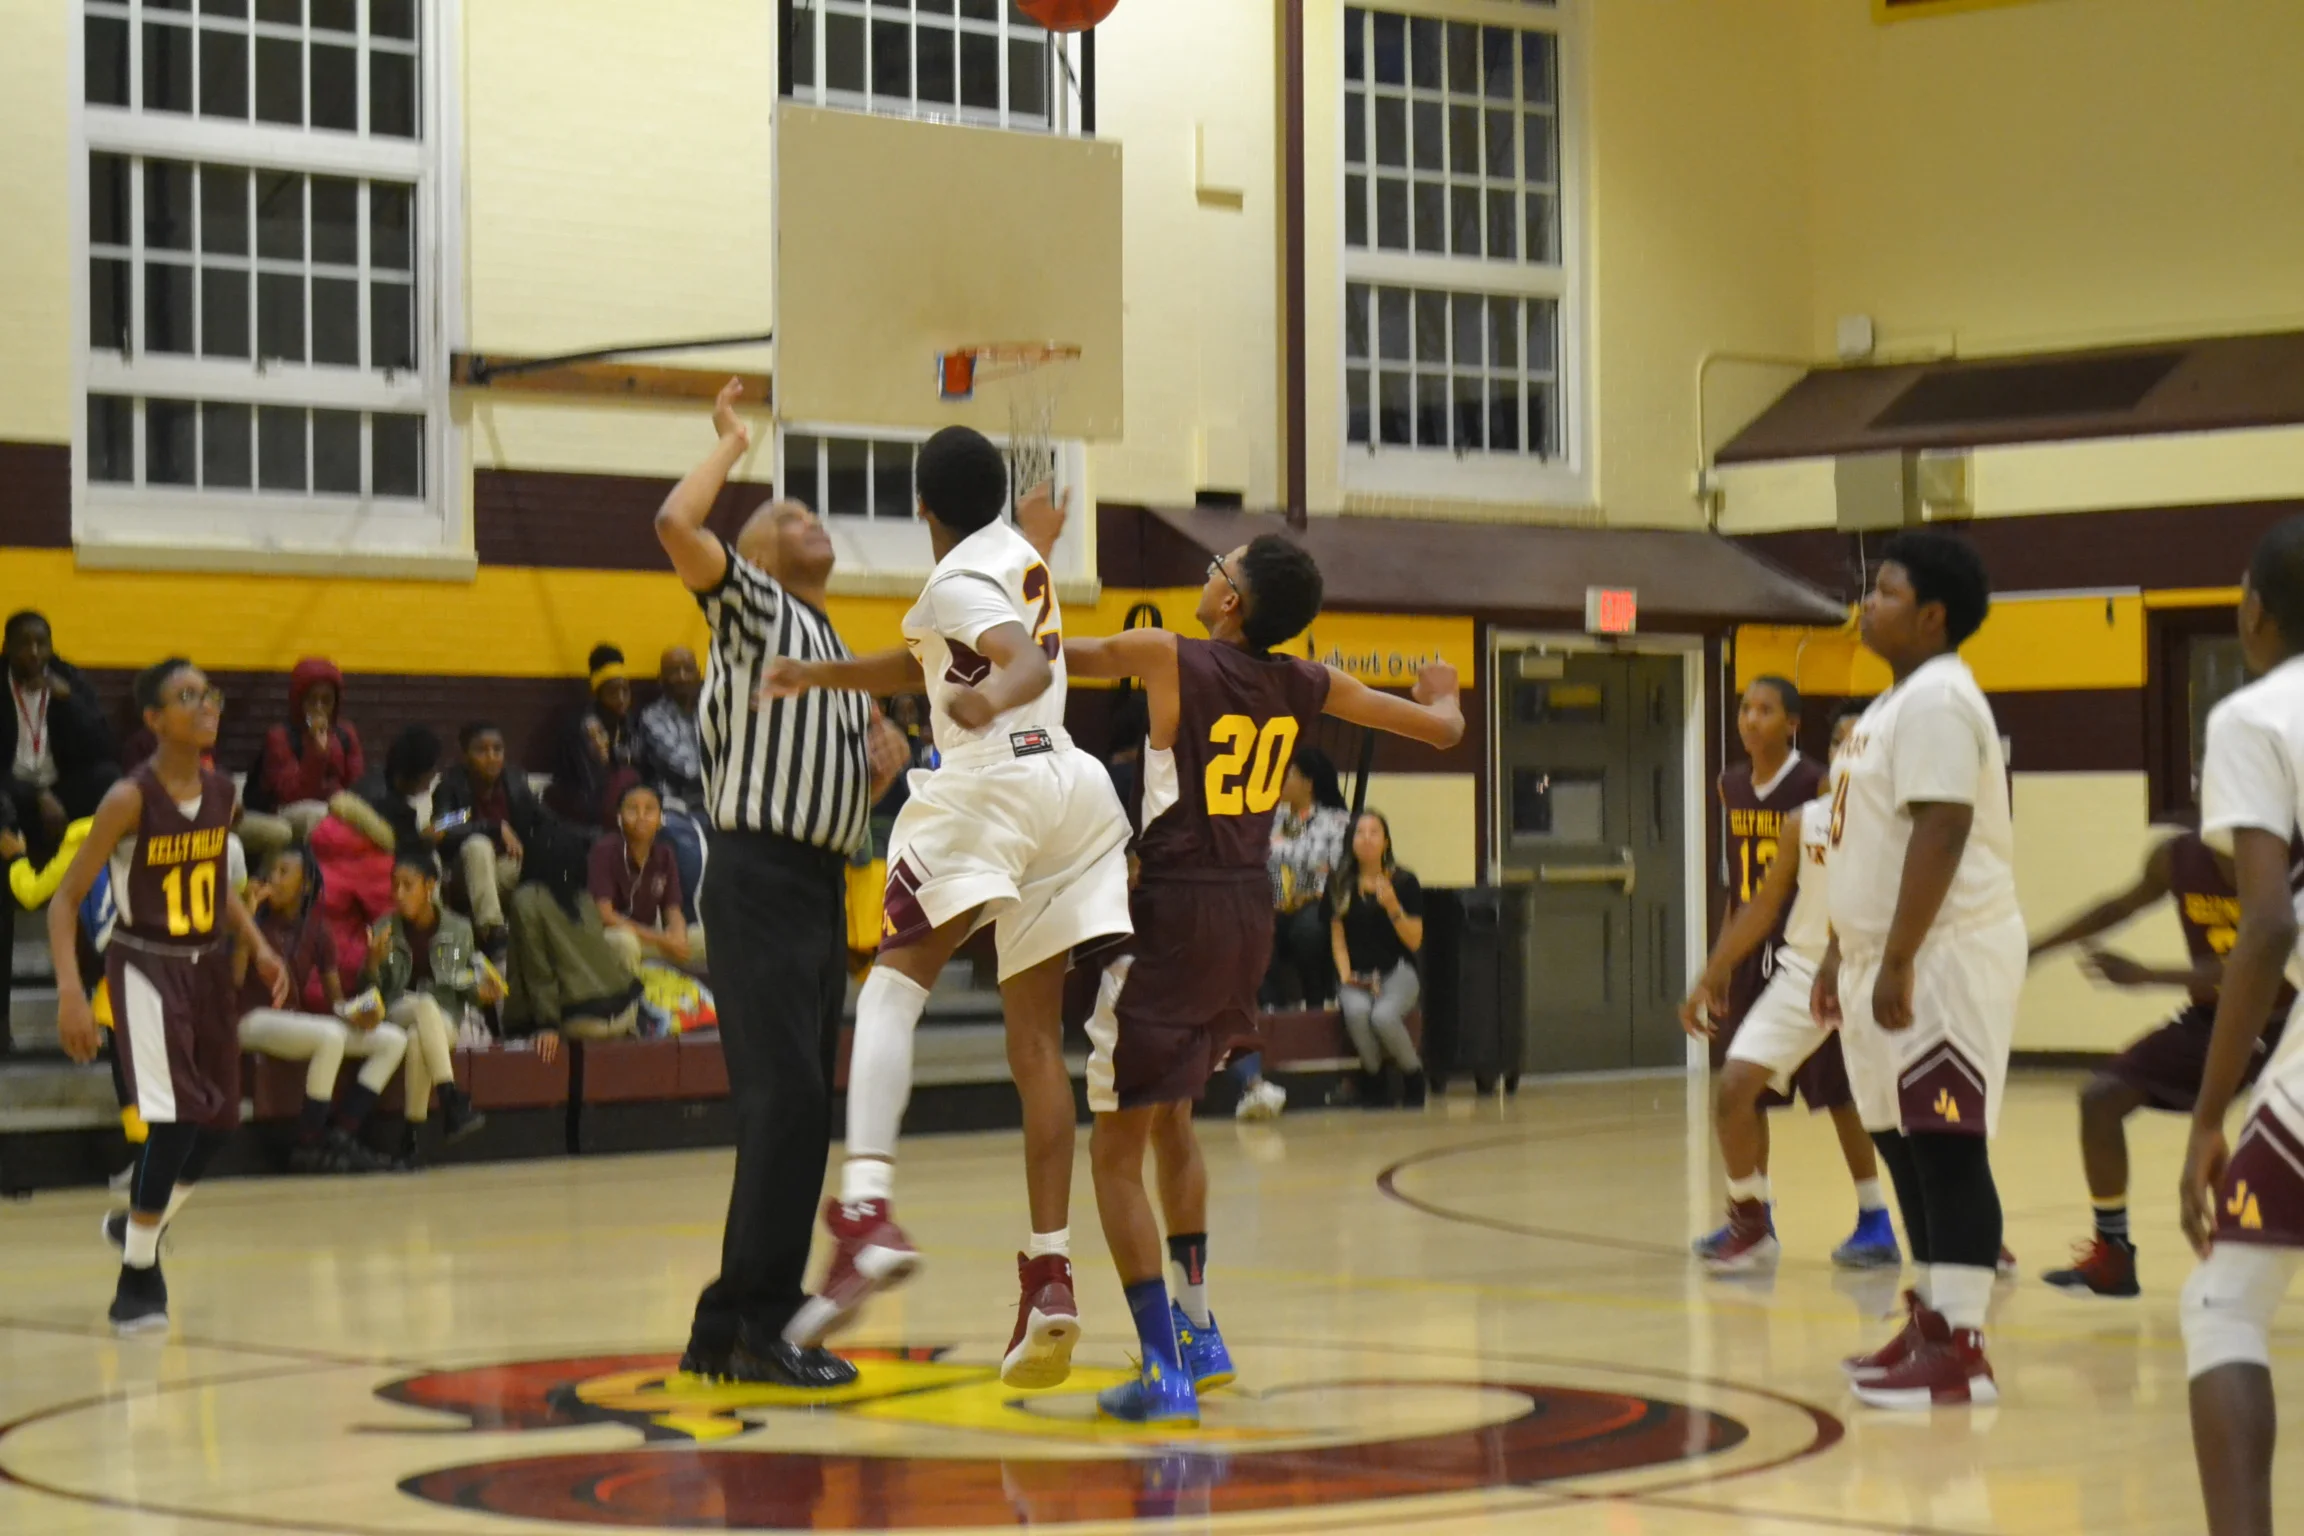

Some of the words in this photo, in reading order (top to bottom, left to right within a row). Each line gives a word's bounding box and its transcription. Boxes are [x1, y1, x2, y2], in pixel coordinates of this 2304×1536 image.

[1205, 714, 1299, 815] 20
[147, 834, 191, 866] KELLY
[162, 861, 215, 936] 10
[1934, 1087, 1960, 1123] JA
[2227, 1179, 2262, 1229] JA
